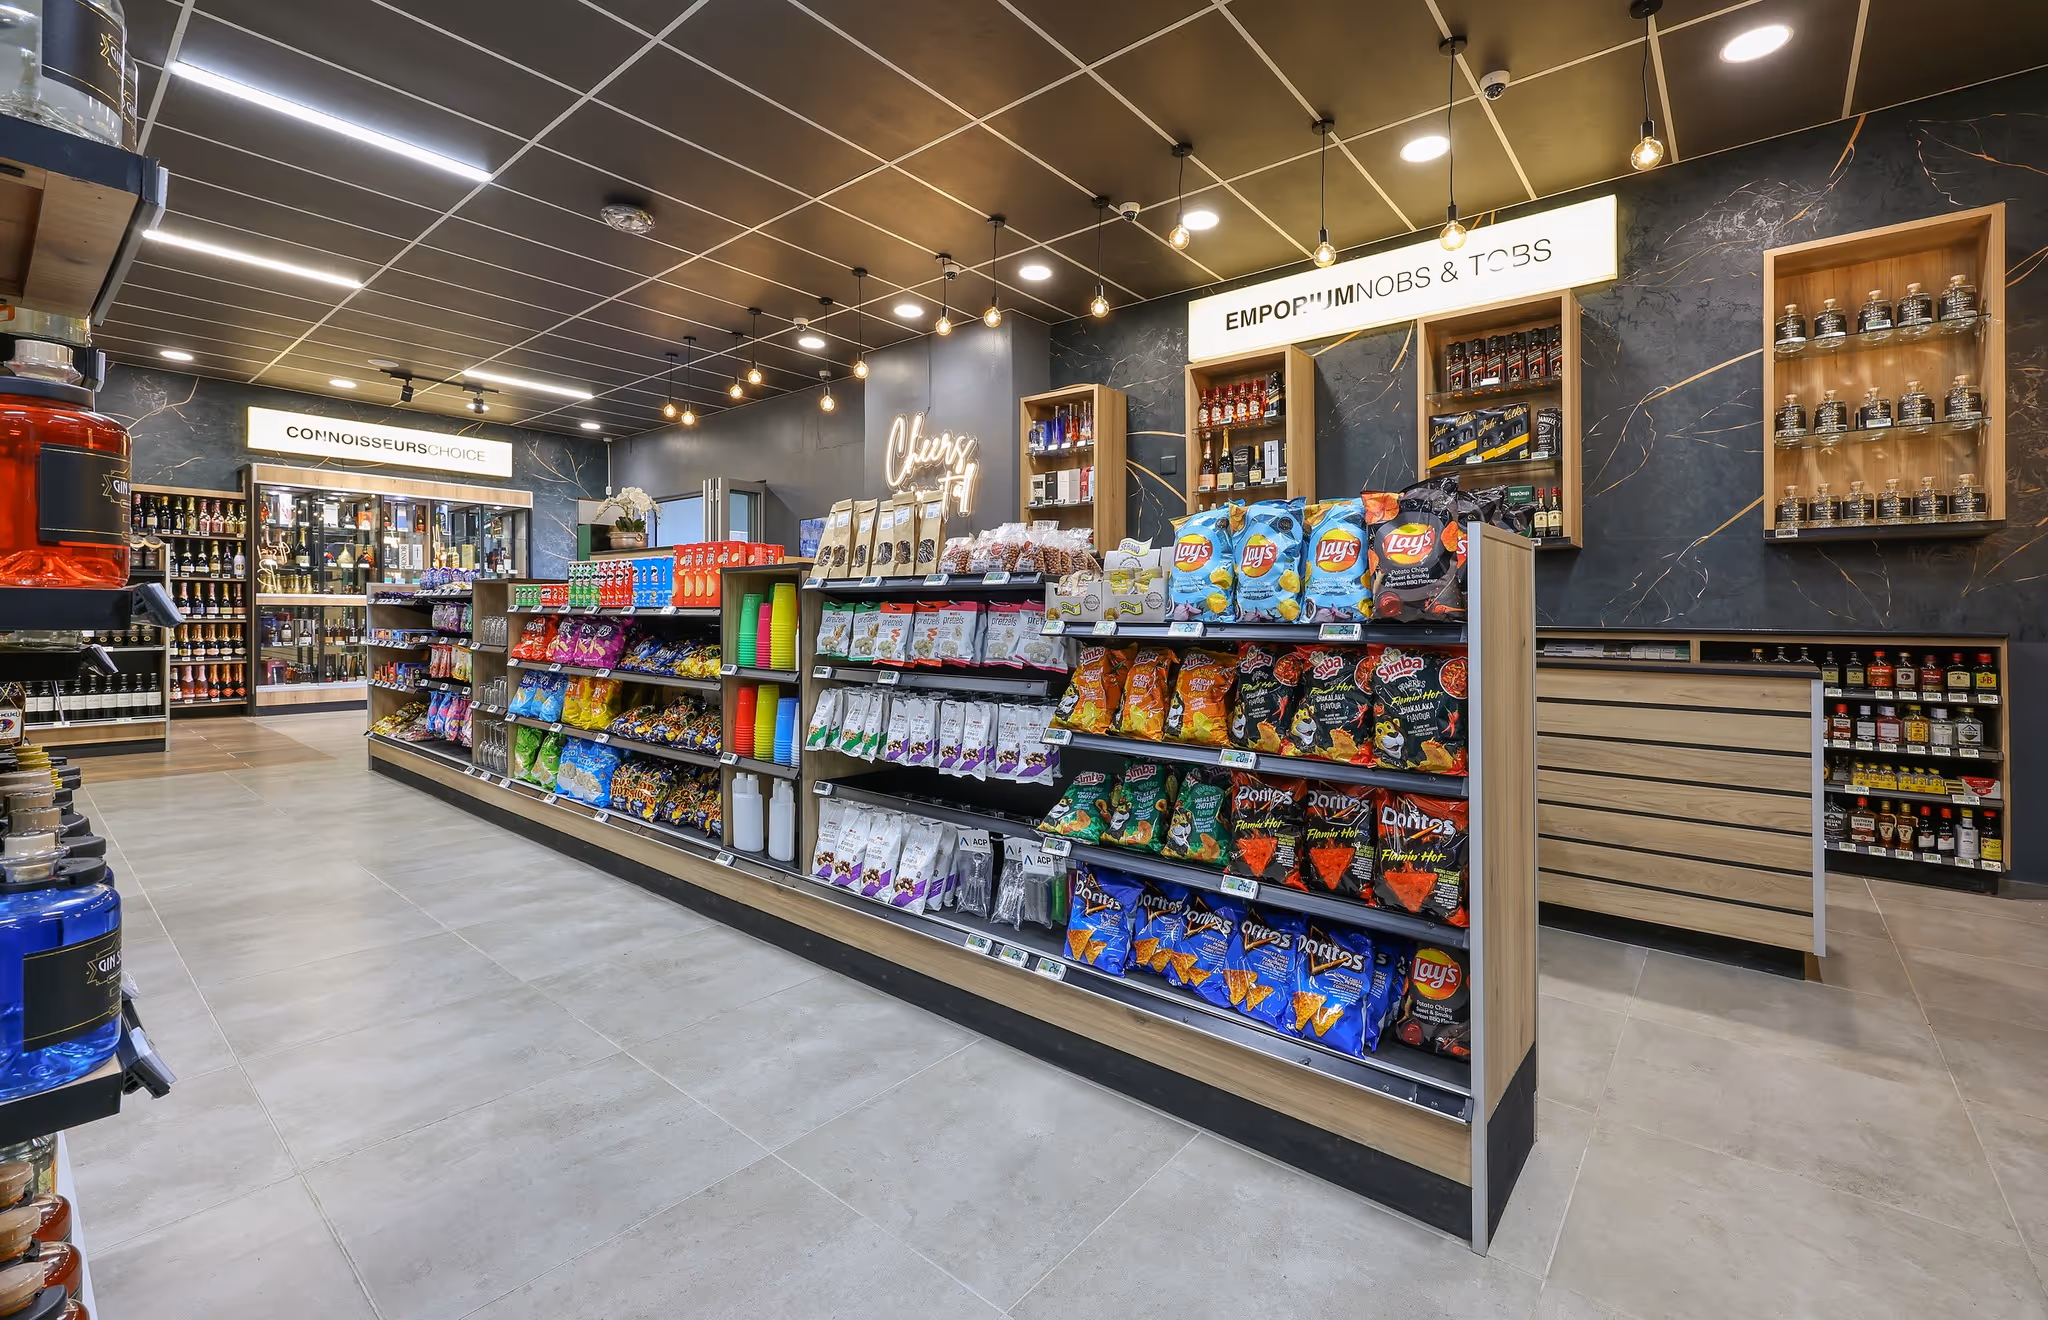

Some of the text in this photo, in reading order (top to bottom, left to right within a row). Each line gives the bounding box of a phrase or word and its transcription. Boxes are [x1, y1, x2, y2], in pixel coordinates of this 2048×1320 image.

[1440, 261, 1459, 283] &
[1469, 239, 1552, 277] TOBS
[1387, 527, 1436, 556] Lay's
[1175, 542, 1210, 563] Lay's
[1242, 543, 1275, 568] Lay's
[1318, 540, 1359, 562] Lay's
[1391, 566, 1429, 576] Potato Chips
[1411, 572, 1429, 580] Smoky
[881, 618, 904, 627] pretzels
[942, 616, 965, 626] pretzels
[991, 616, 1017, 627] pretzels
[1081, 647, 1105, 662] imba
[1377, 656, 1422, 683] Simba
[1423, 689, 1442, 701] Hot
[1407, 711, 1431, 723] FLAVOUR
[1125, 765, 1156, 780] Simba
[1235, 786, 1294, 805] Doritos
[1307, 790, 1370, 812] Doritos
[1264, 817, 1284, 828] Hot
[1381, 806, 1455, 835] Doritos
[1342, 827, 1360, 839] Hot
[973, 838, 988, 846] ACP
[1037, 856, 1052, 865] ACP
[1421, 849, 1446, 862] Hot
[1297, 934, 1366, 971] Doritos
[98, 954, 115, 972] GIN
[1413, 958, 1458, 989] Lay's
[1416, 1000, 1452, 1013] Potato Chips
[1434, 1010, 1453, 1020] Smoky
